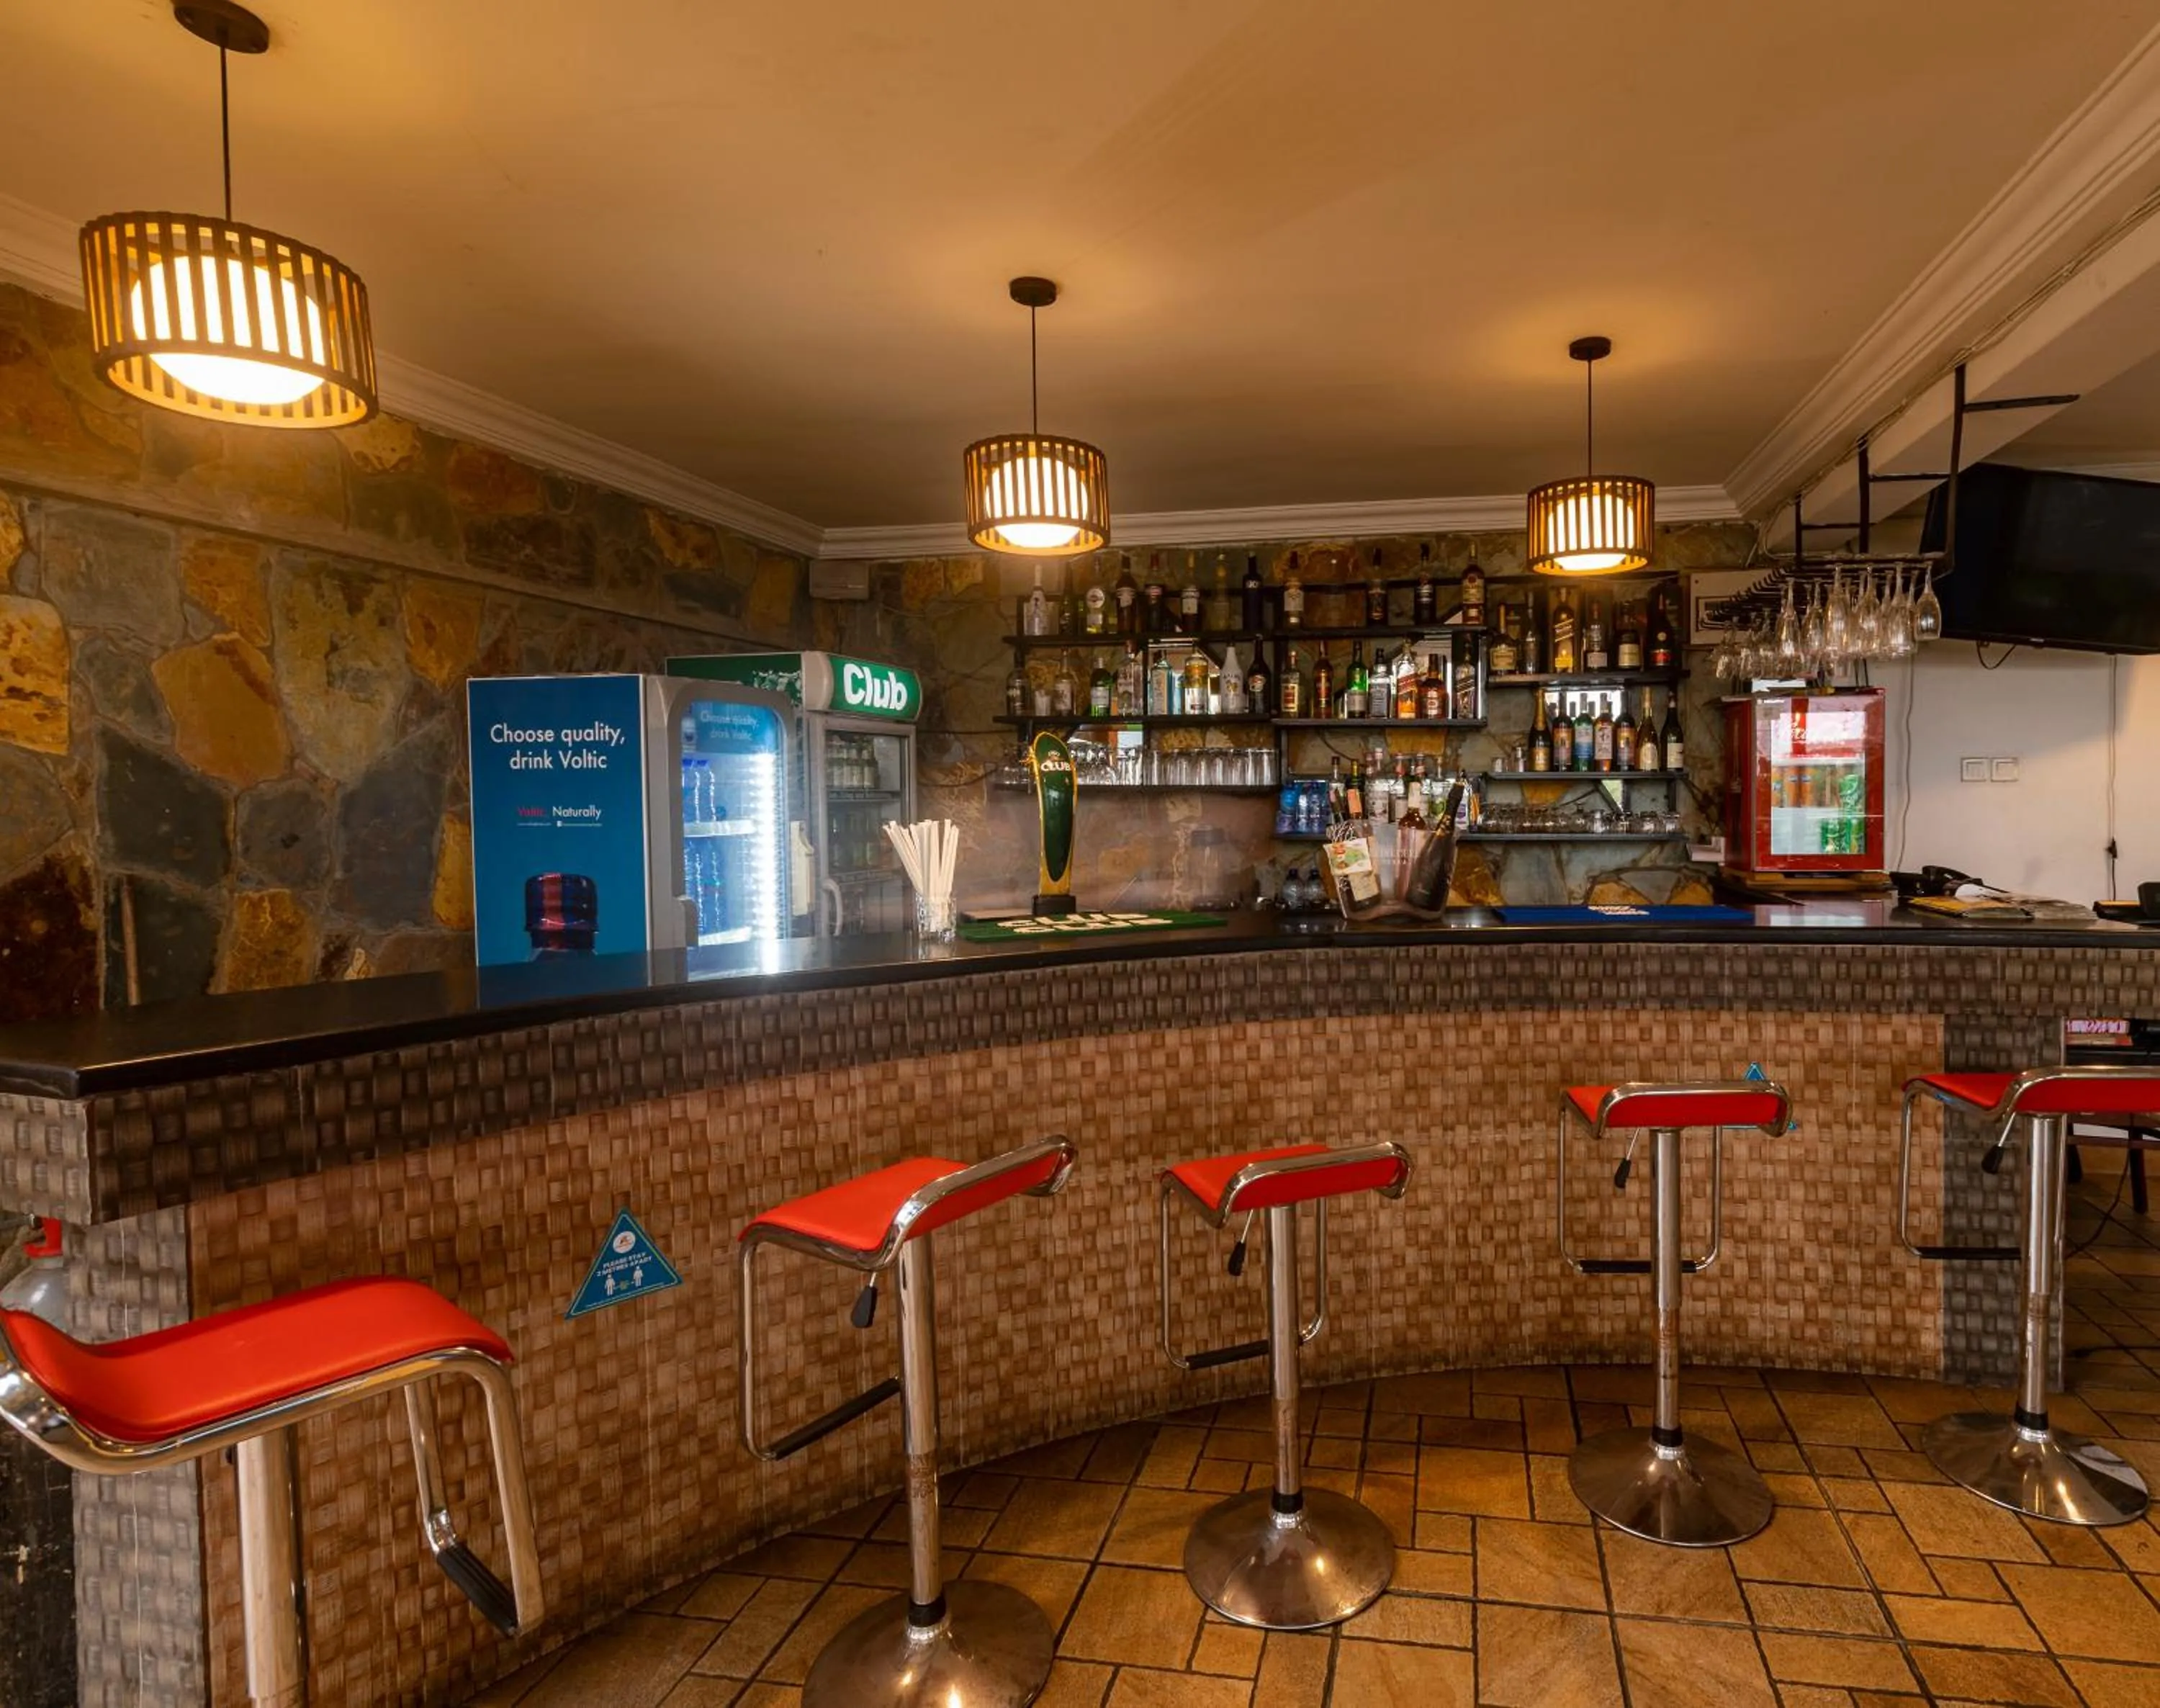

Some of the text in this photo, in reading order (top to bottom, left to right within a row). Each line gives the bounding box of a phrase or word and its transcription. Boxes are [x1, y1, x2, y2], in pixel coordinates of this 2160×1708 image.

[843, 663, 908, 711] Club
[490, 721, 626, 747] Choose quality,
[510, 748, 608, 769] drink Voltic
[1040, 760, 1071, 771] CLUB
[552, 805, 602, 821] Naturally
[629, 1252, 646, 1262] STAY
